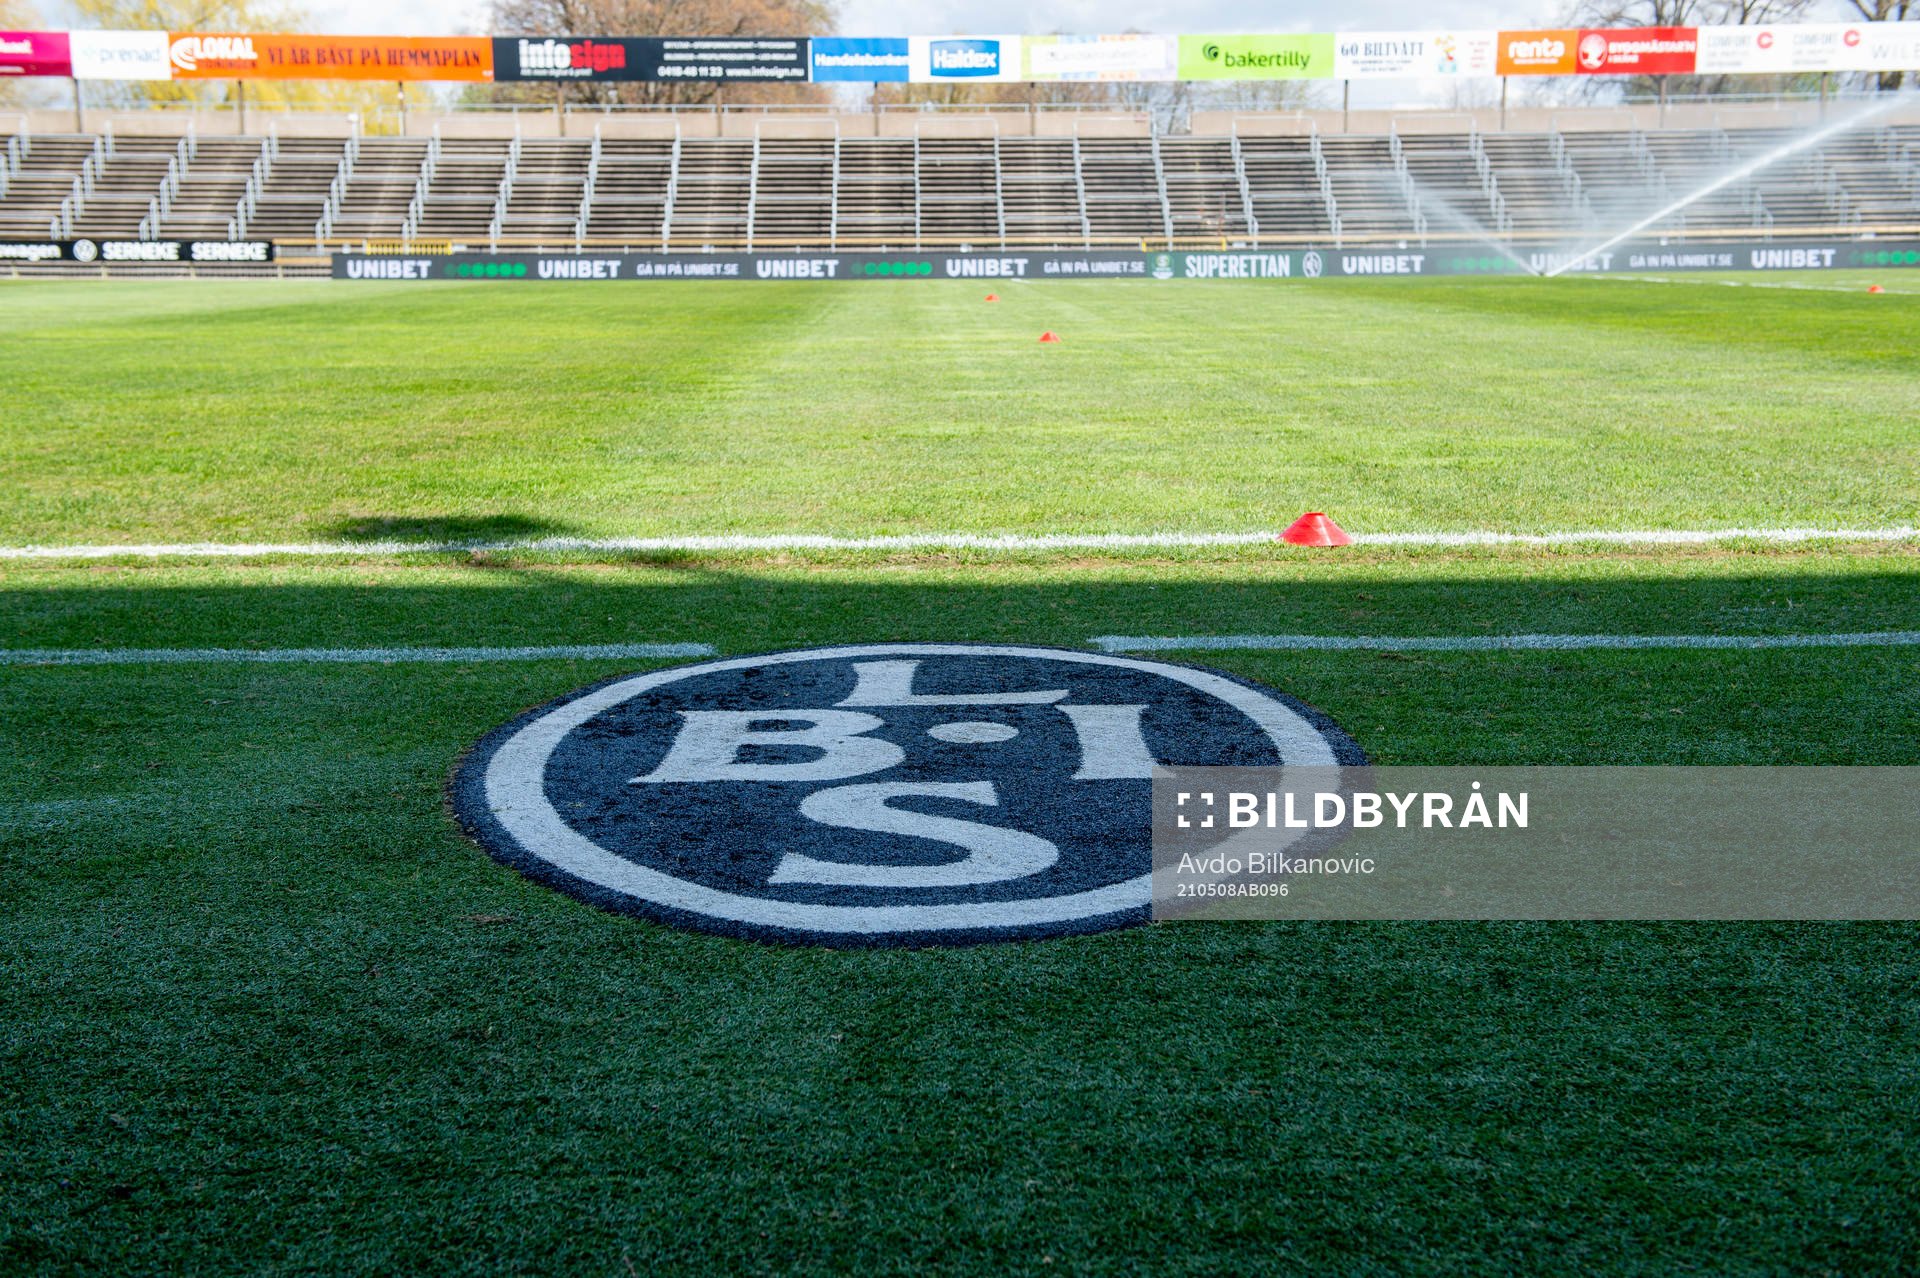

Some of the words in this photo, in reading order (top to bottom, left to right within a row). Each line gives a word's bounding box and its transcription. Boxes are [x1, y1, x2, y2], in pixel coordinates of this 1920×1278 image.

[194, 37, 258, 60] LOKAL
[268, 47, 284, 65] VI
[387, 47, 481, 67] HEMMAPLAN
[518, 38, 626, 72] infosign
[1508, 37, 1565, 58] renta
[815, 53, 909, 67] Handelsbanken
[933, 48, 997, 69] Haldex
[102, 242, 181, 261] SERNEKE
[190, 242, 269, 261] SERNEKE
[1647, 255, 1658, 268] IN
[1677, 253, 1733, 267] UNIBET.SE
[1751, 248, 1836, 268] UNIBET
[346, 260, 432, 278] UNIBET
[537, 259, 621, 278] UNIBET
[637, 261, 654, 276] GÅ
[655, 264, 665, 276] IN
[667, 261, 683, 276] PÅ
[684, 263, 739, 276] UNIBET.SE
[756, 259, 839, 278] UNIBET
[946, 258, 1029, 277] UNIBET
[1044, 259, 1060, 274] GÅ
[1061, 262, 1073, 274] IN
[1074, 259, 1090, 274] PÅ
[1091, 261, 1145, 274] UNIBET.SE
[1185, 254, 1290, 278] SUPERETTAN
[1342, 254, 1425, 274] UNIBET
[1531, 252, 1613, 272] UNIBET
[835, 659, 1070, 708] L
[629, 708, 907, 784] B
[768, 780, 1060, 887] S
